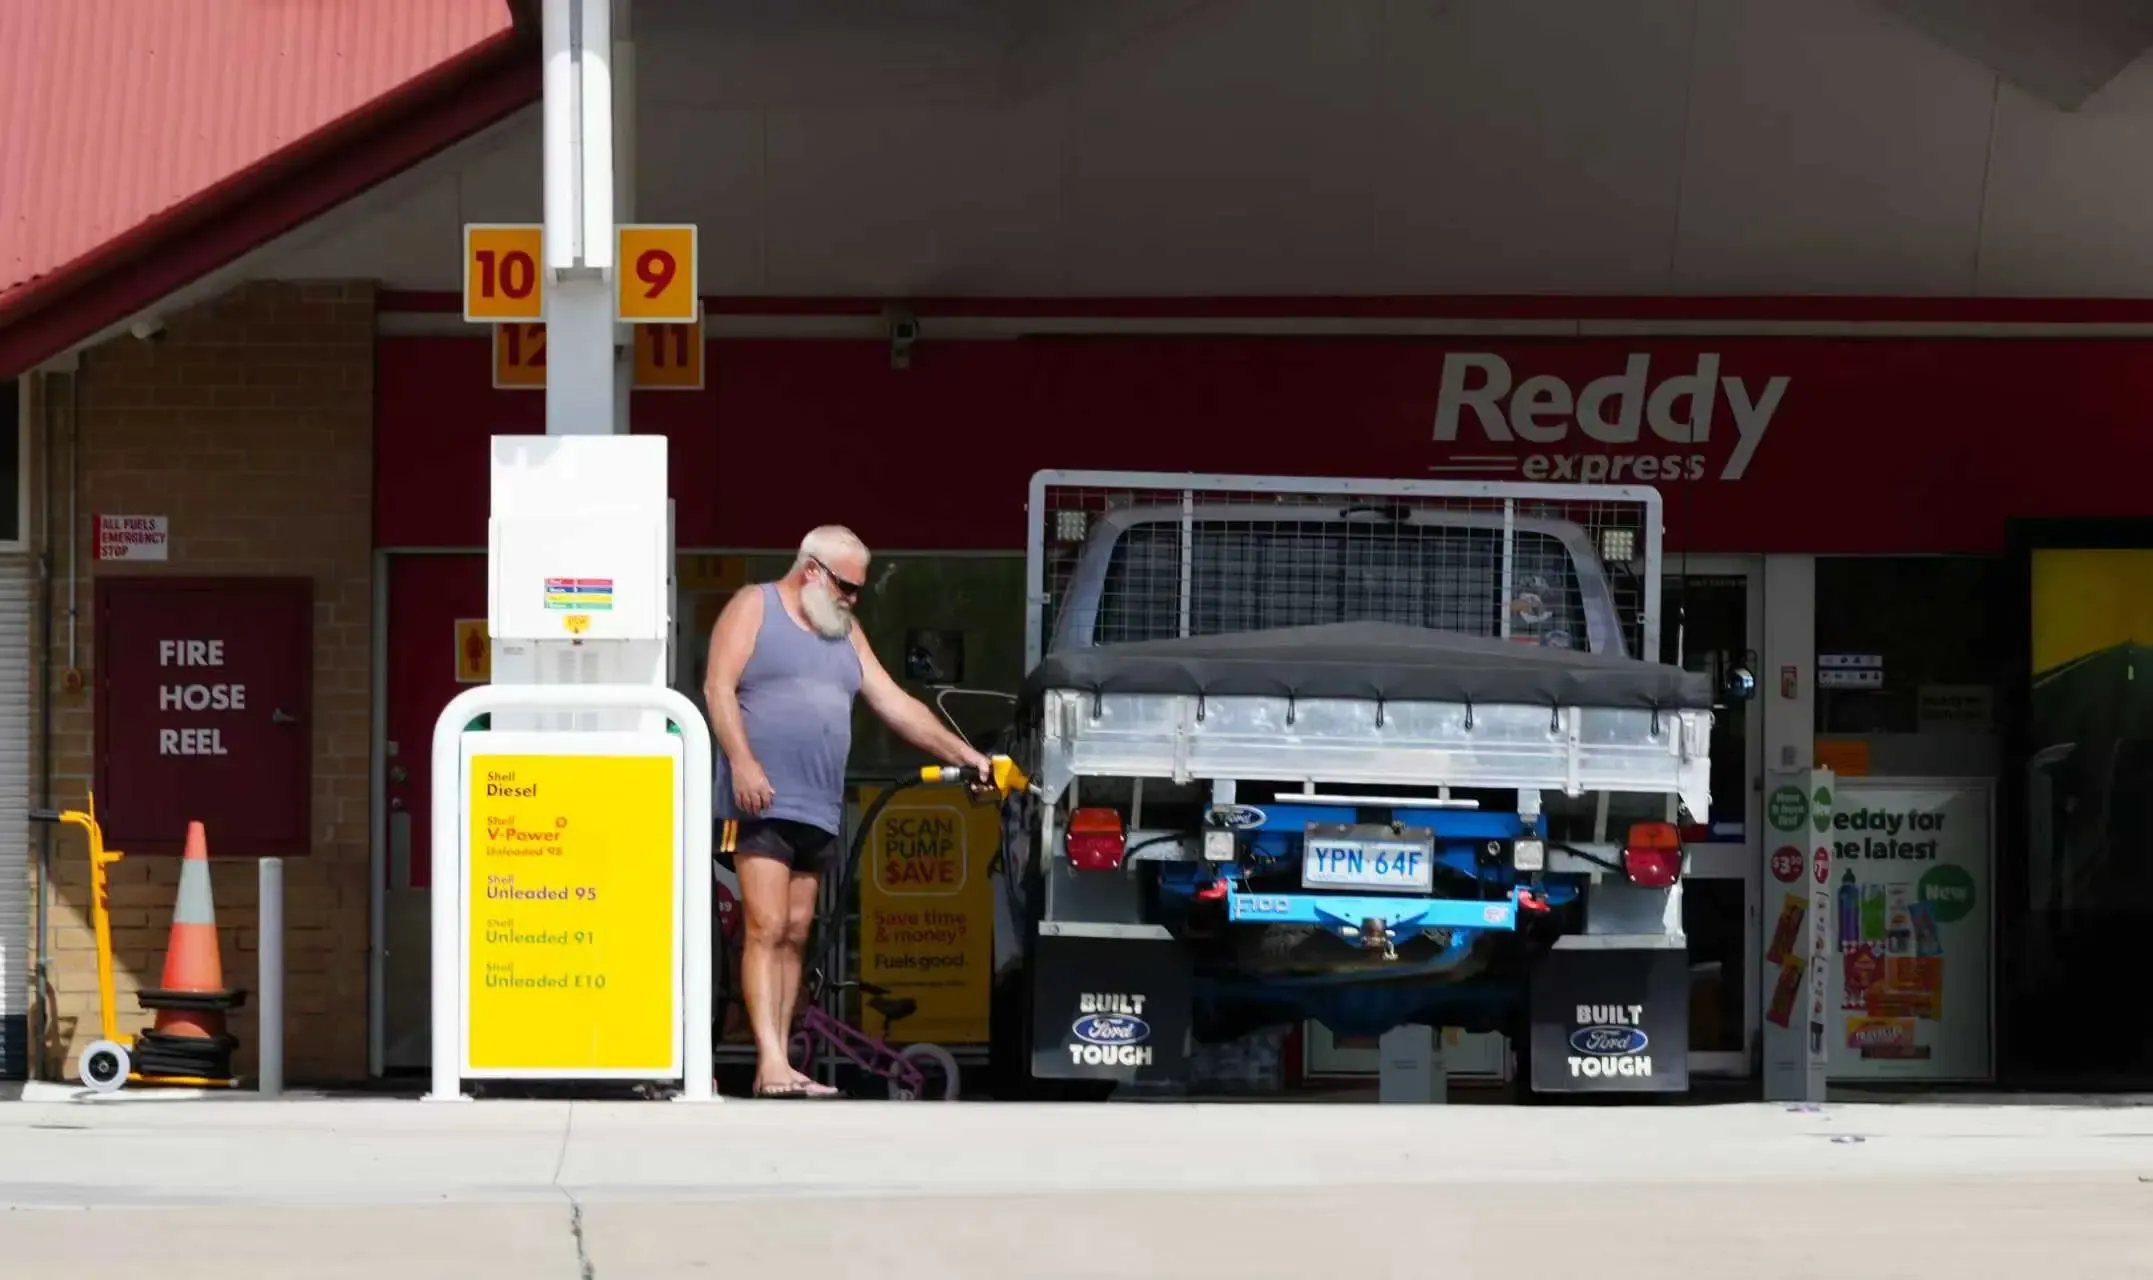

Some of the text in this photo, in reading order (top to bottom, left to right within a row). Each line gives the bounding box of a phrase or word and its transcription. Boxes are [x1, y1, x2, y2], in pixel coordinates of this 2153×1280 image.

[475, 250, 535, 299] 10
[635, 249, 676, 299] 9
[1432, 352, 1792, 480] Reddy
[1522, 452, 1705, 485] express
[103, 519, 155, 531] ALL FUELS
[102, 531, 165, 544] EMERGENCY
[101, 545, 129, 557] STOP
[159, 639, 225, 667] FIRE
[159, 683, 246, 711] HOSE
[159, 728, 228, 755] REEL
[487, 770, 516, 781] Shell
[487, 783, 537, 798] Diesel
[487, 815, 515, 826] Shell
[885, 816, 952, 838] SCAN
[1908, 808, 1946, 831] for
[487, 827, 561, 842] V-Power
[486, 846, 543, 856] Unleaded
[885, 839, 954, 860] PUMP
[1864, 837, 1939, 860] latest
[487, 874, 515, 885] Shell
[885, 859, 955, 886] $AVE
[487, 885, 597, 901] Unleaded 95
[1925, 884, 1970, 903] New
[874, 906, 967, 926] Save time
[1235, 894, 1290, 918] F100
[486, 918, 514, 928] Shell
[486, 929, 593, 945] Unleaded 91
[875, 926, 967, 945] & money?
[486, 973, 606, 990] Unleaded E10
[1080, 992, 1147, 1014] BUILT
[1576, 1004, 1643, 1025] BUILT
[1087, 1017, 1135, 1039] Ford
[1585, 1029, 1632, 1050] Ford
[1069, 1043, 1153, 1066] TOUGH
[1568, 1055, 1653, 1078] TOUGH
